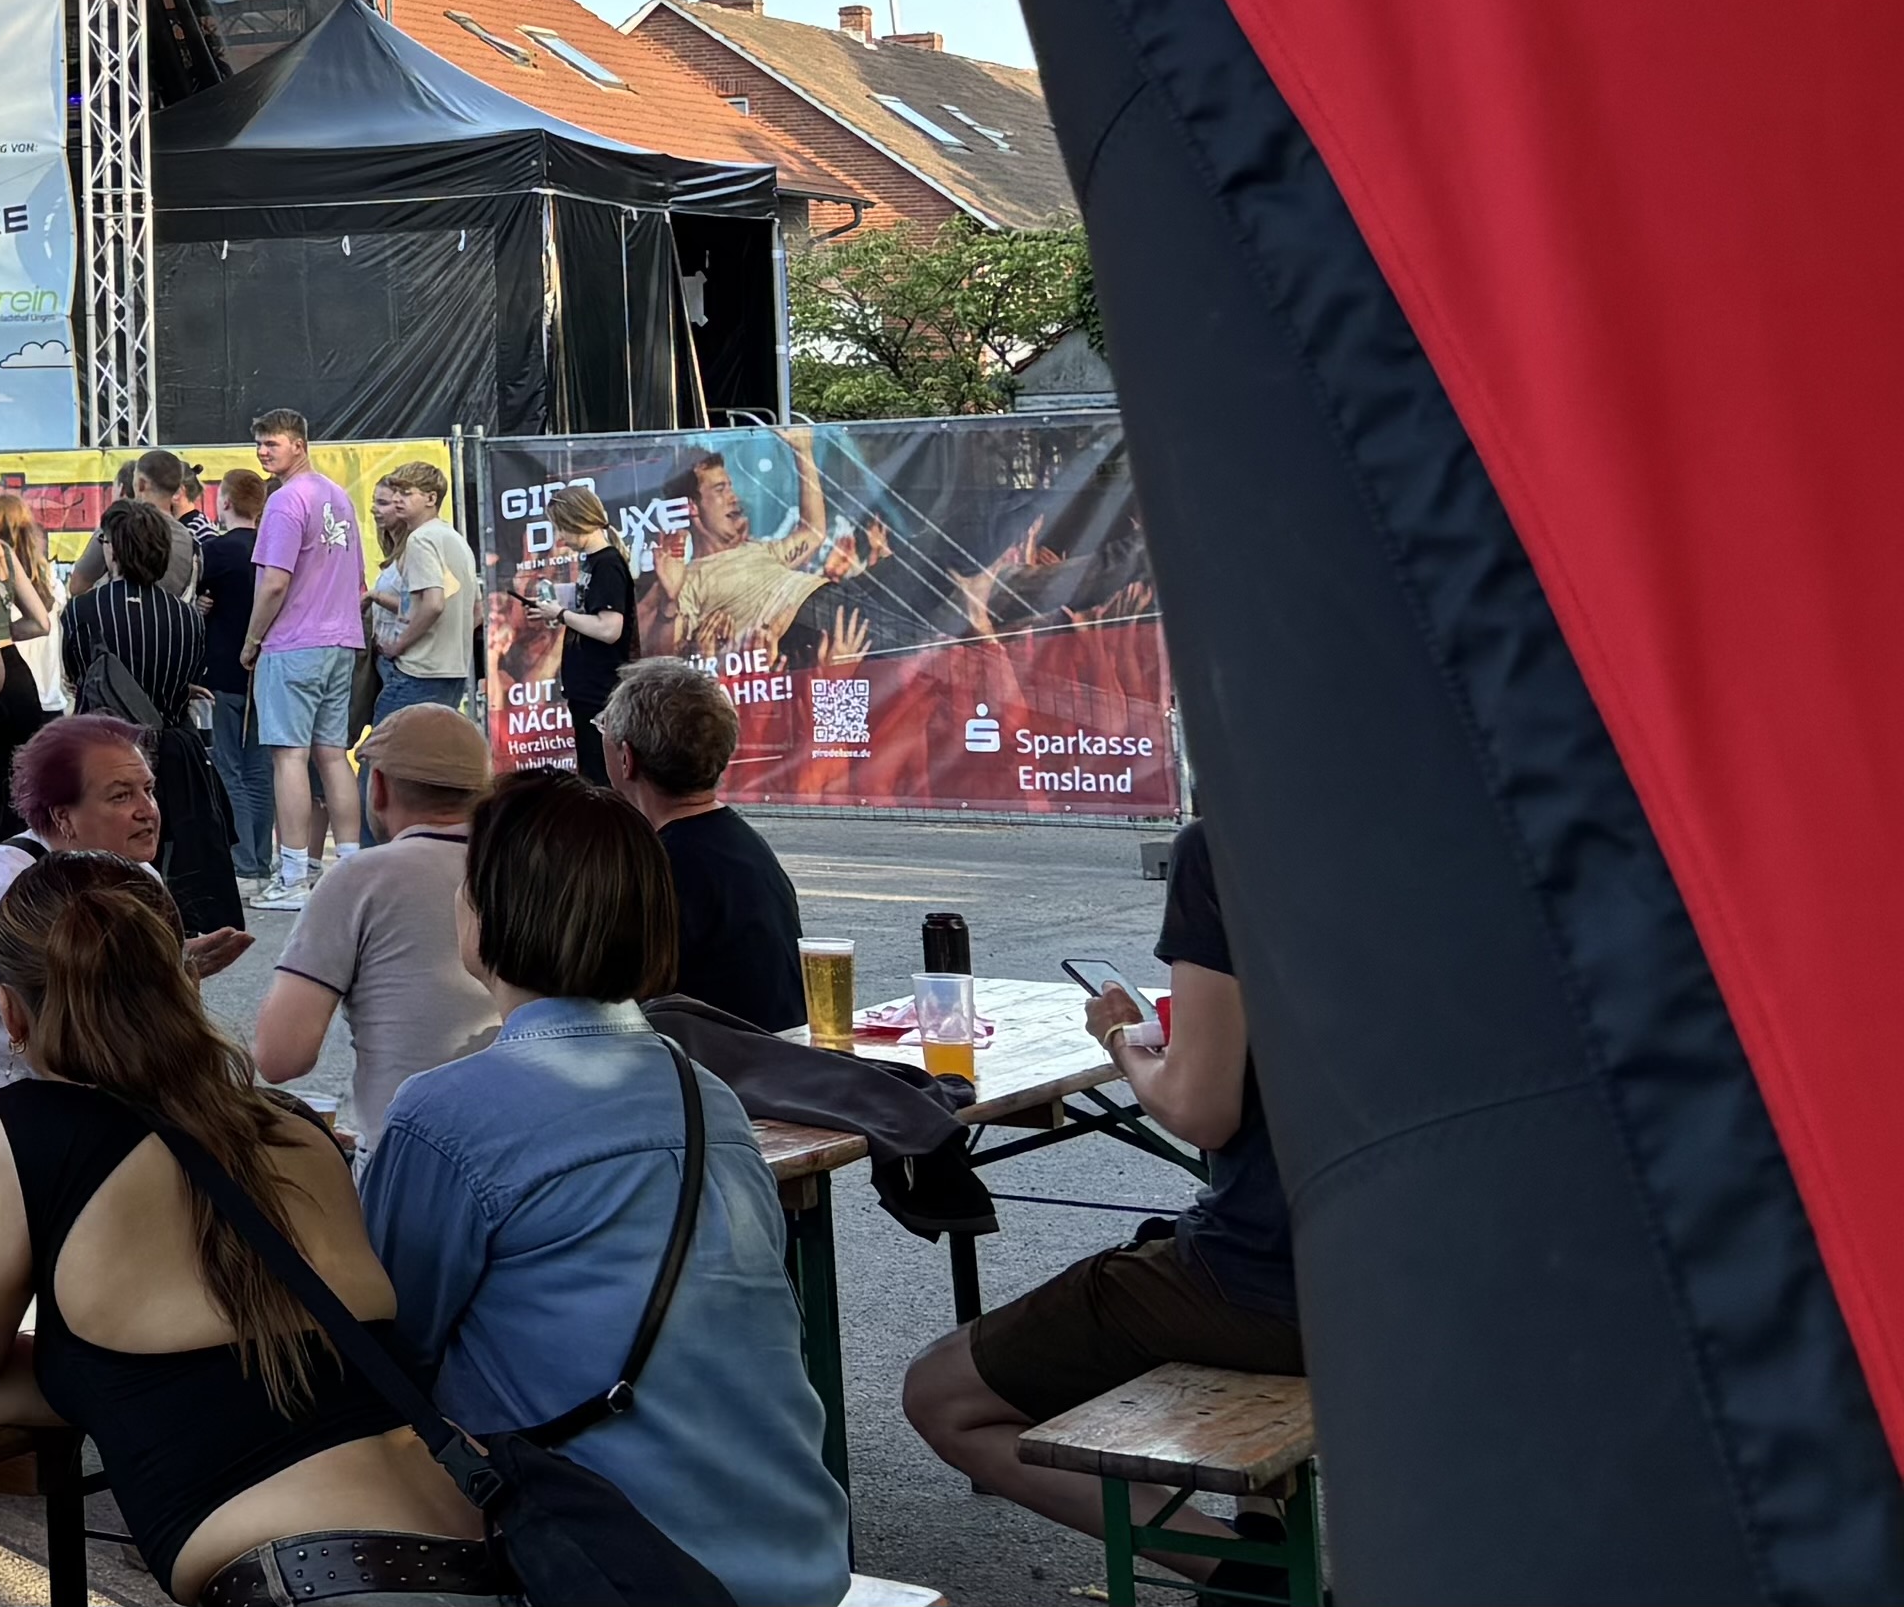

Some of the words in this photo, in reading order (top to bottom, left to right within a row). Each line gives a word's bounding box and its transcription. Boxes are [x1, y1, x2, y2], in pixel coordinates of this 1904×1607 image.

[508, 678, 555, 706] GUT
[725, 648, 770, 677] DIE
[1015, 728, 1153, 757] Sparkasse
[1018, 765, 1133, 794] Emsland
